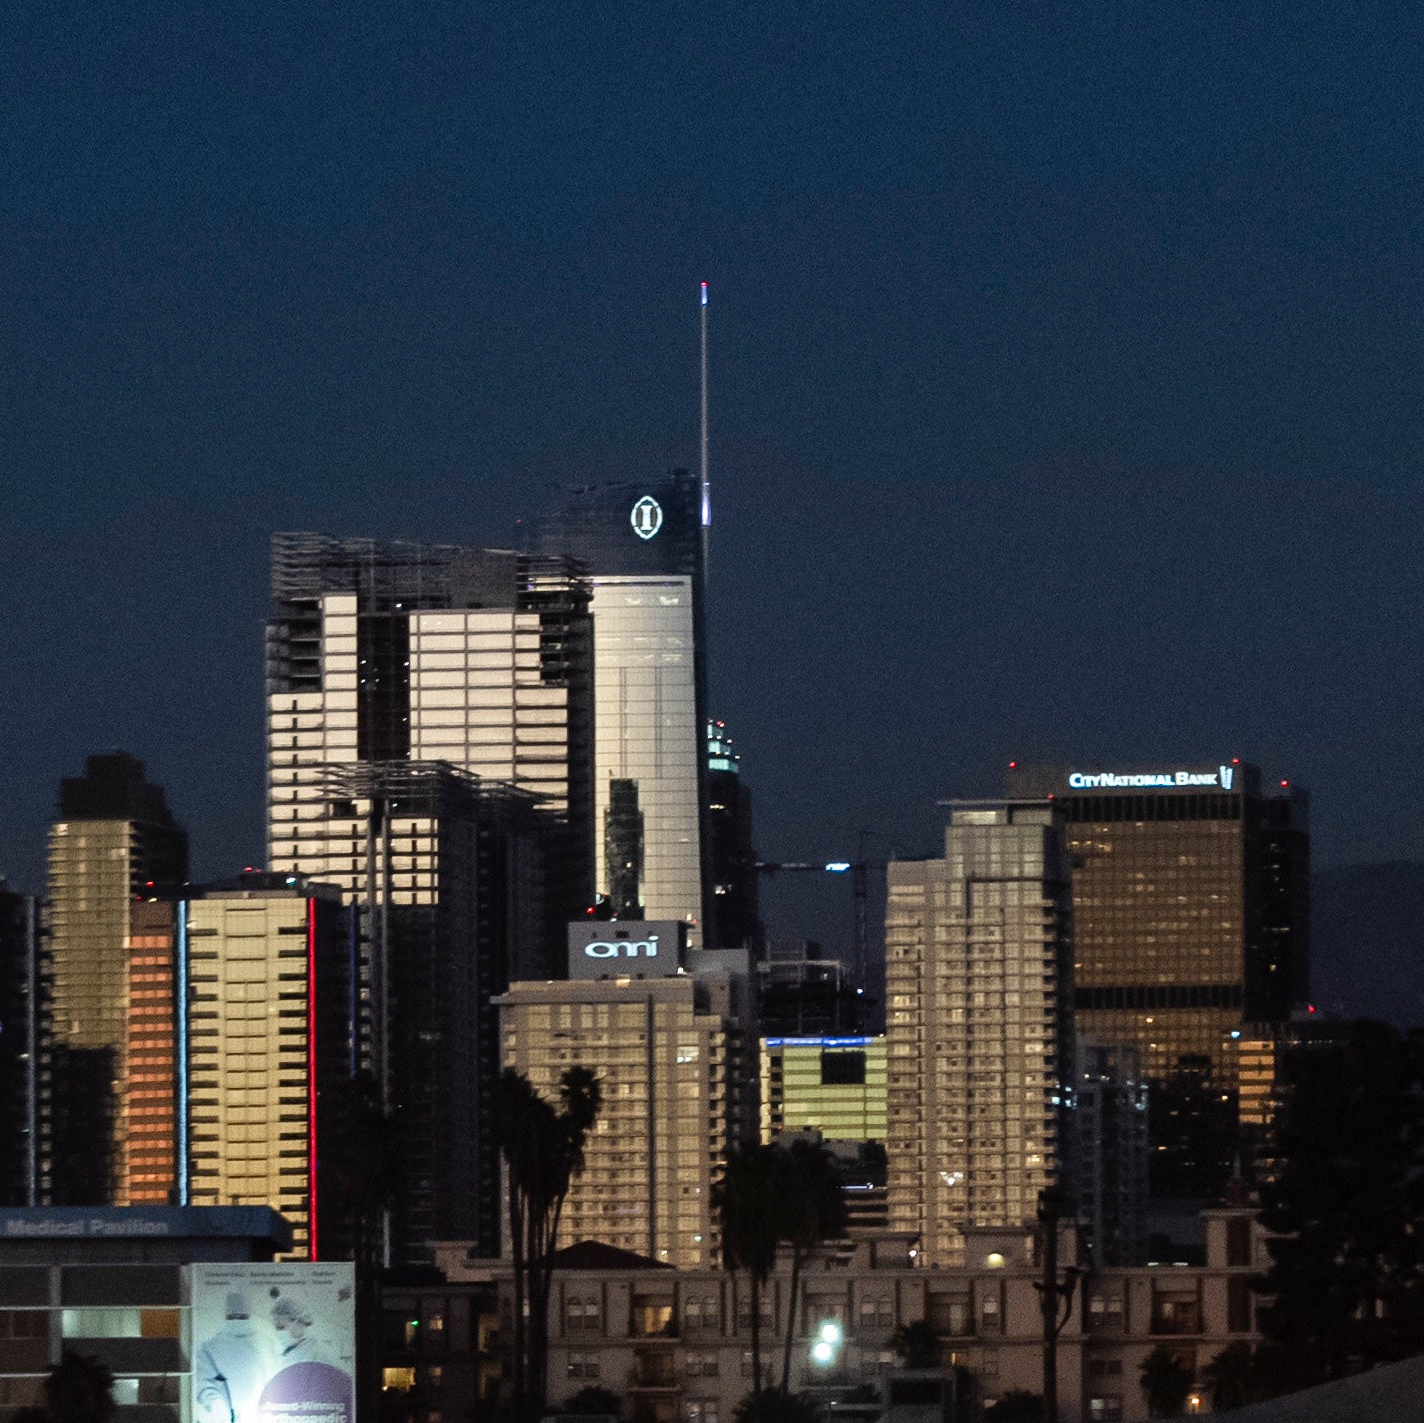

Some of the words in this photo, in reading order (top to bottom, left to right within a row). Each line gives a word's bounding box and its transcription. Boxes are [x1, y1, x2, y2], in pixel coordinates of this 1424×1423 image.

[584, 935, 659, 958] onni
[5, 1219, 84, 1236] Medical
[89, 1219, 168, 1236] Pavilion
